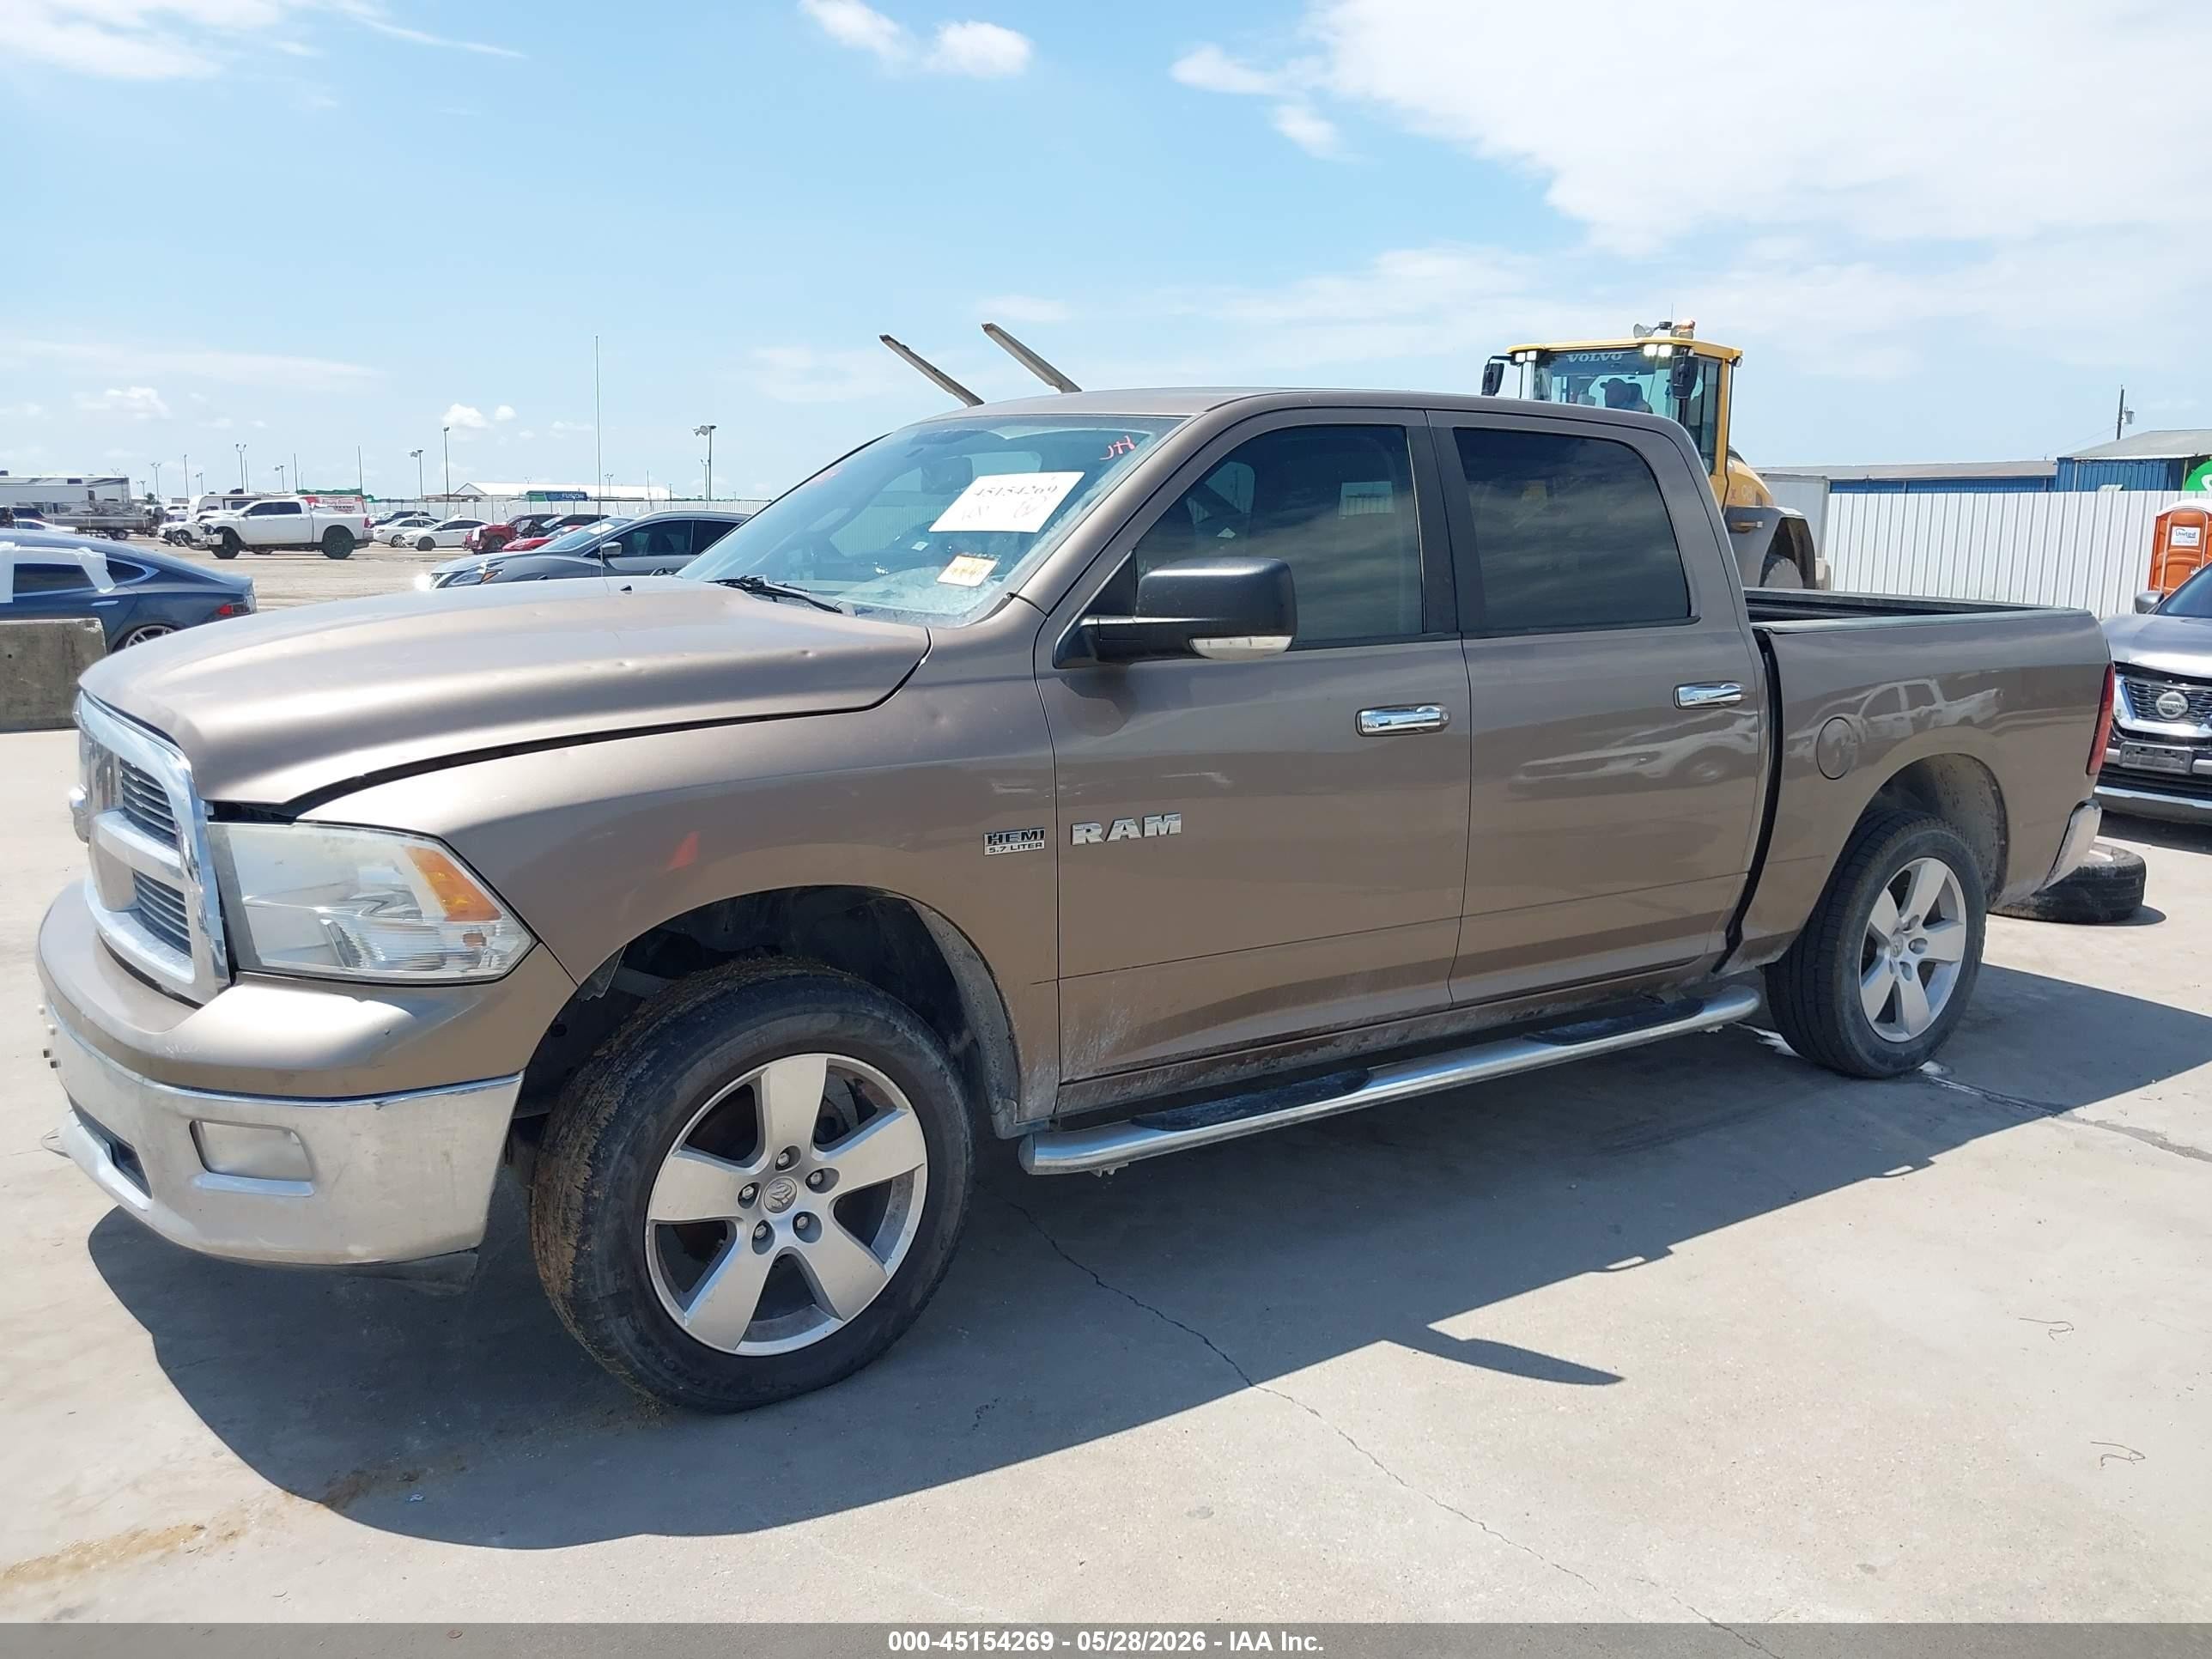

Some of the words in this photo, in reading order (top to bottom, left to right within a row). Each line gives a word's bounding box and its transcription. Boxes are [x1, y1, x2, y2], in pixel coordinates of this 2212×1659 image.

[1565, 352, 1623, 363] VOLVO
[1070, 812, 1182, 846] RAM
[986, 828, 1045, 846] HEMI
[1010, 842, 1042, 851] LITER
